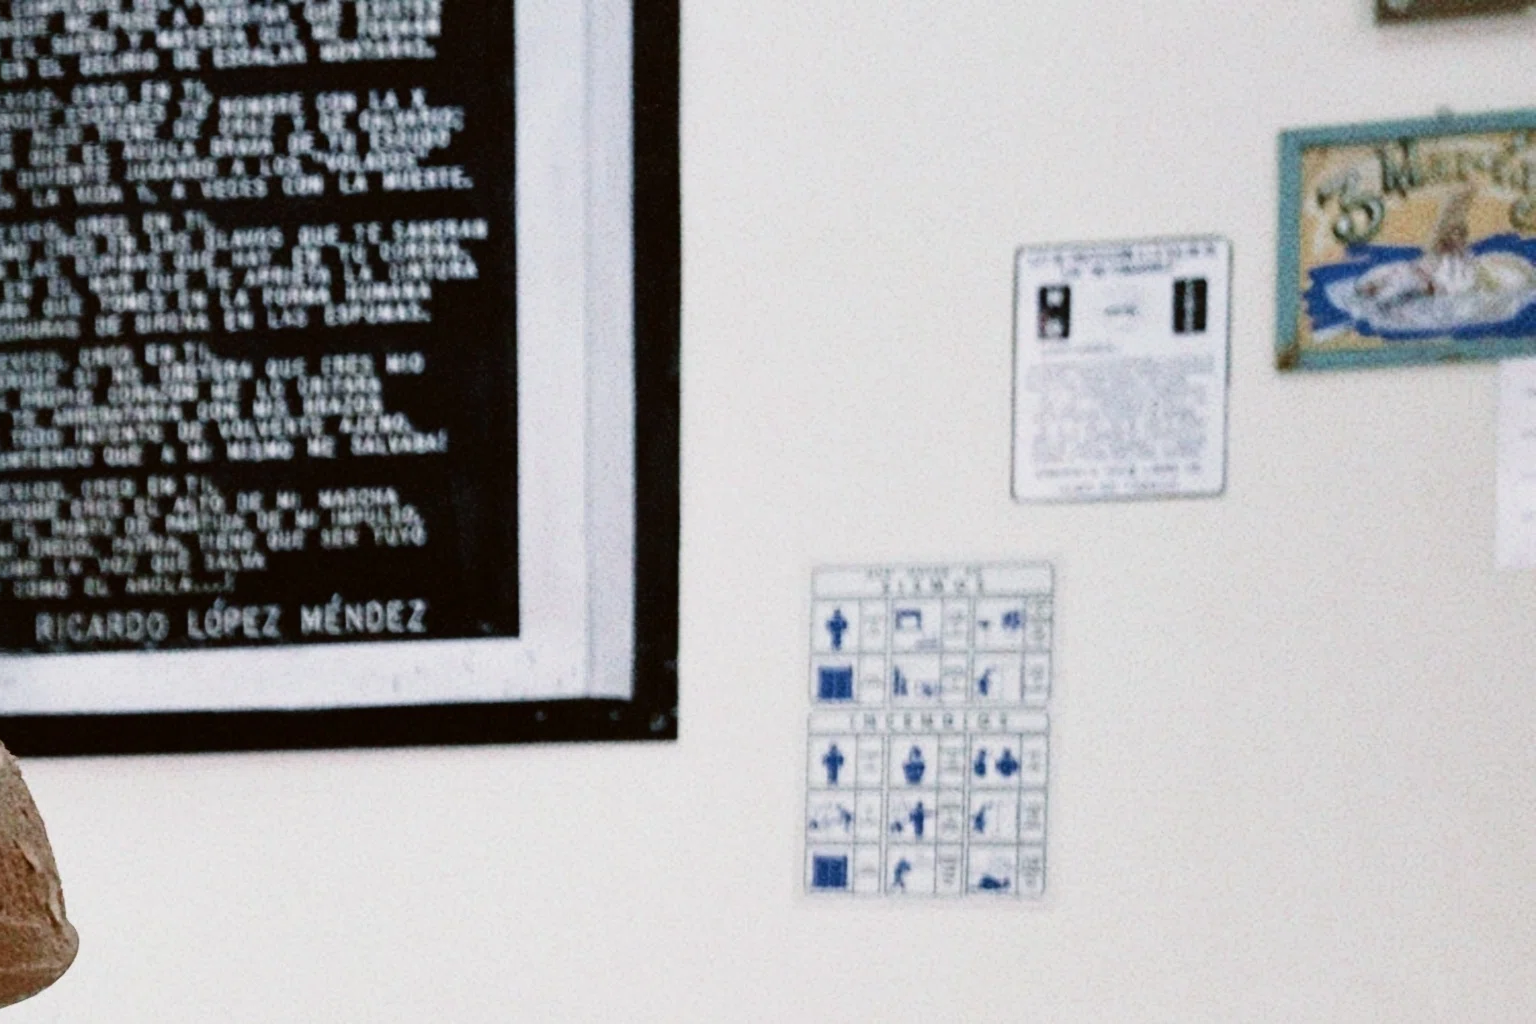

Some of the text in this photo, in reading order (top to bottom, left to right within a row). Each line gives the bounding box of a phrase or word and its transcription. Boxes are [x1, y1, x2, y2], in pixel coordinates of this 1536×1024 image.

[35, 591, 430, 643] RICARDO LÓPEZ MÉNDEZ
